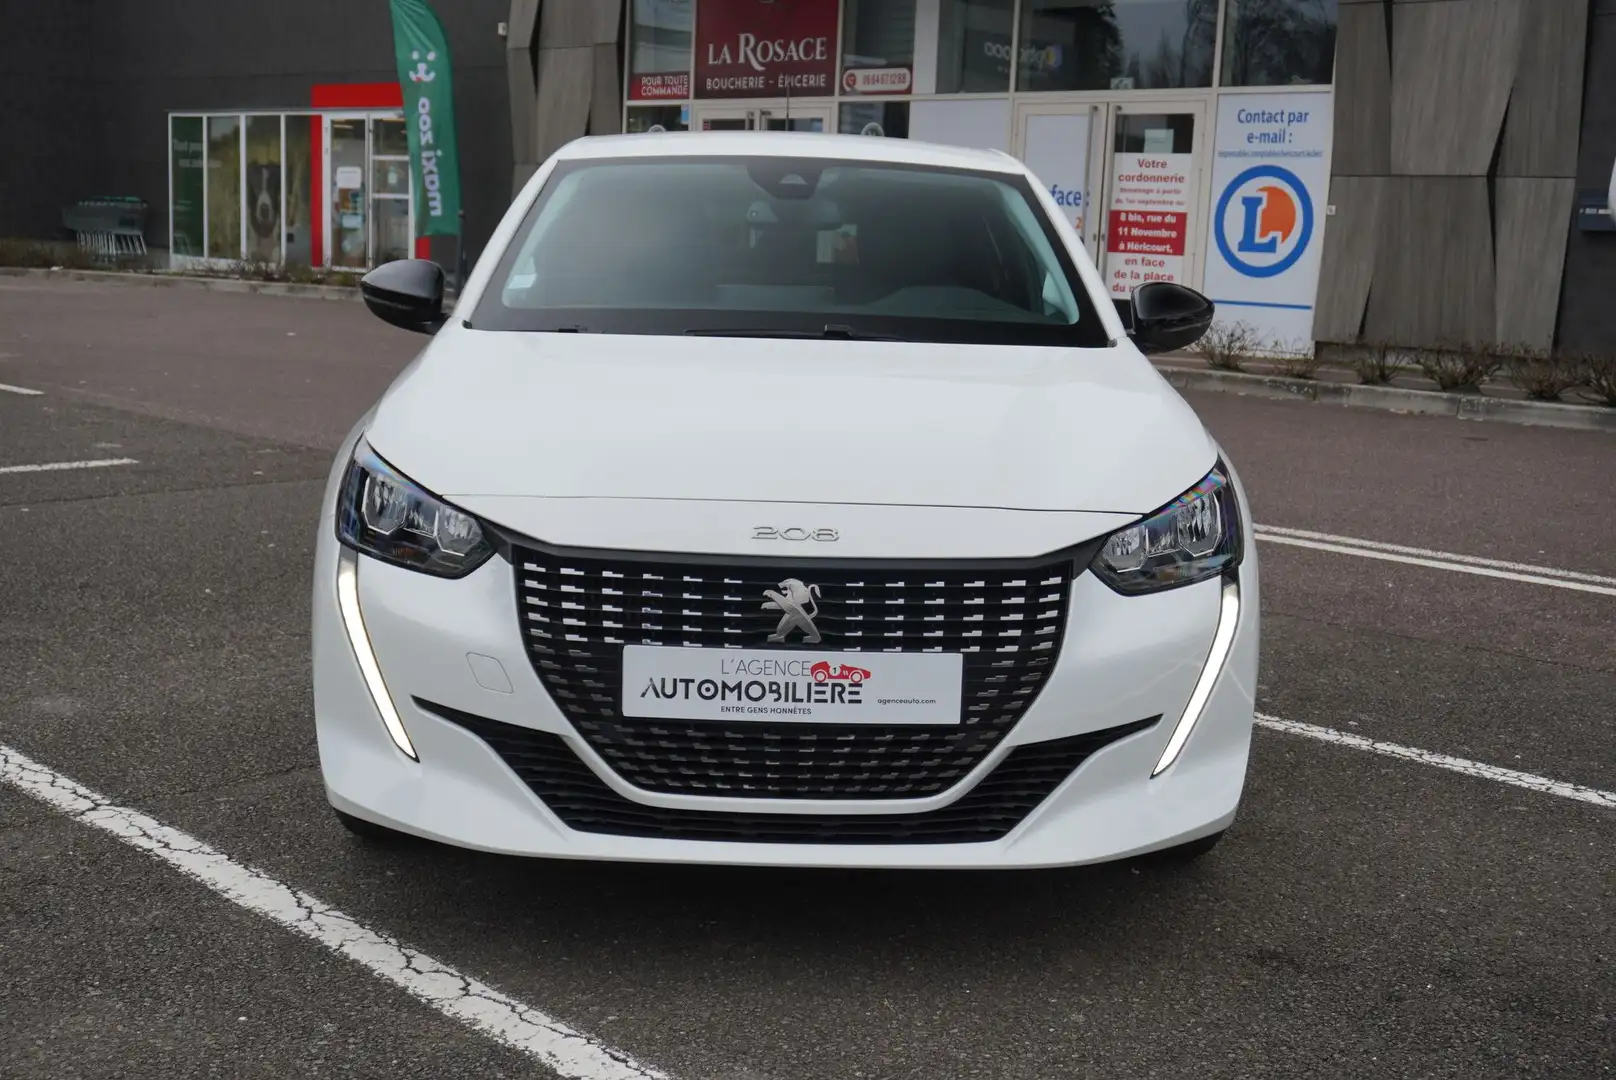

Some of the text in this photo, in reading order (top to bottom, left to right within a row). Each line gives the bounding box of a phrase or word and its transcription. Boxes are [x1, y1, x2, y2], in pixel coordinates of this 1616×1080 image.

[707, 32, 828, 71] LA ROSACE
[641, 75, 688, 86] POUR TOUTE
[705, 75, 765, 90] BOUCHERIE
[641, 85, 688, 96] COMMANDE
[1237, 108, 1309, 127] Contact par
[1138, 158, 1168, 169] Votre
[1118, 173, 1185, 184] cordonnerie
[1120, 213, 1126, 221] 8
[1164, 214, 1177, 223] du
[1118, 227, 1177, 238] 11 Novembre
[1141, 256, 1165, 268] face
[1114, 270, 1174, 282] de la place
[1112, 283, 1125, 292] du
[751, 526, 840, 542] 208
[721, 659, 811, 677] L'AGENCE
[877, 697, 937, 705] agenceauto.com
[720, 706, 745, 714] ENTRE
